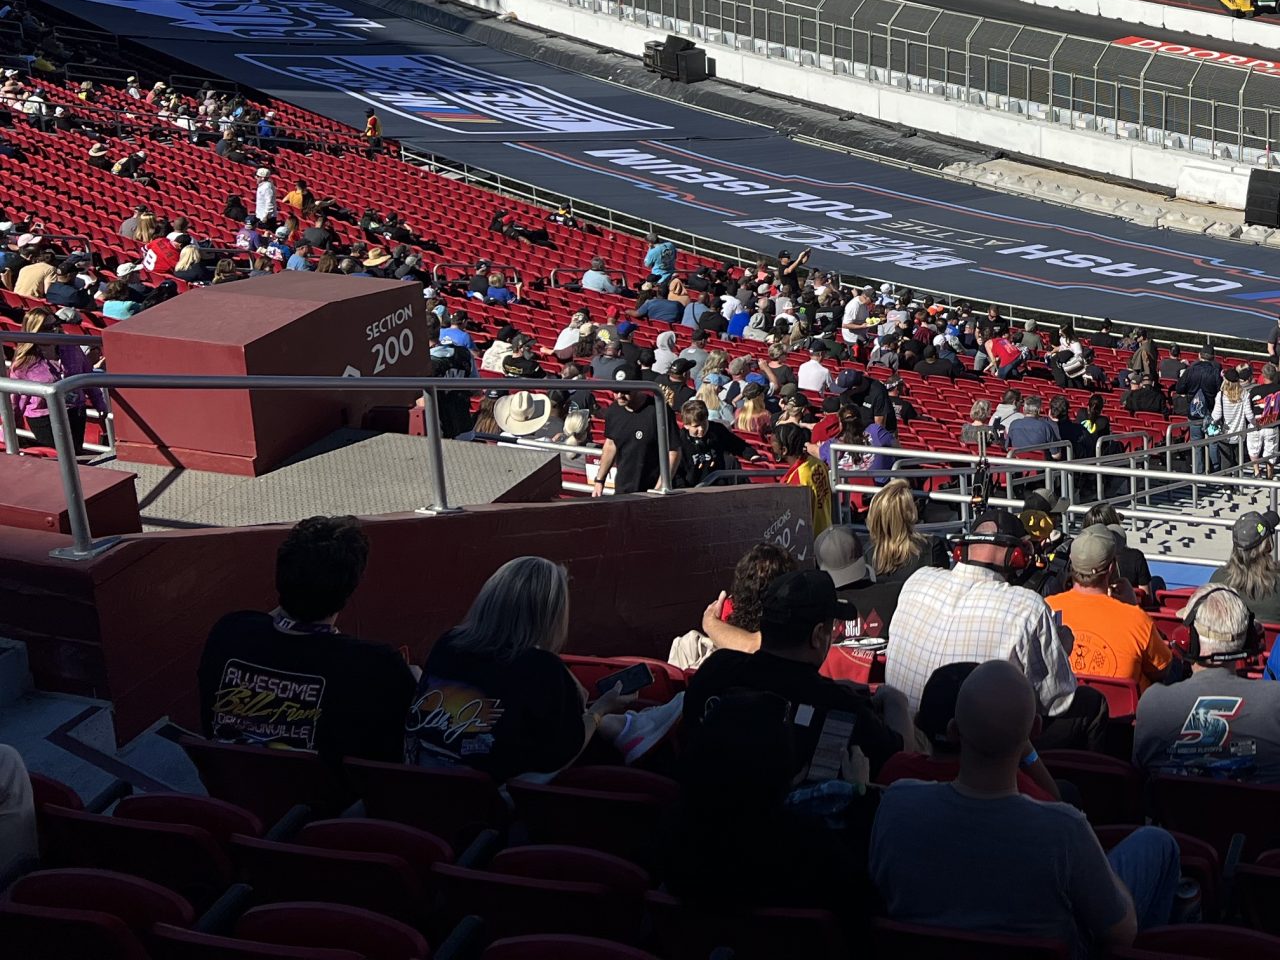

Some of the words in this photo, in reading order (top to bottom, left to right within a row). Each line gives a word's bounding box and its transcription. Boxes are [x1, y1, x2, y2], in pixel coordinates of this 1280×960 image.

[492, 99, 592, 123] CUP
[584, 148, 893, 222] COLISEUM
[722, 217, 977, 271] BUSCH
[881, 220, 955, 239] THE
[956, 237, 1015, 247] AT
[995, 244, 1243, 292] CLASH
[366, 303, 413, 341] SECTION
[371, 328, 414, 375] 200
[763, 509, 792, 540] SECTIONS
[224, 667, 321, 701] AWESOME
[1174, 695, 1247, 747] 5
